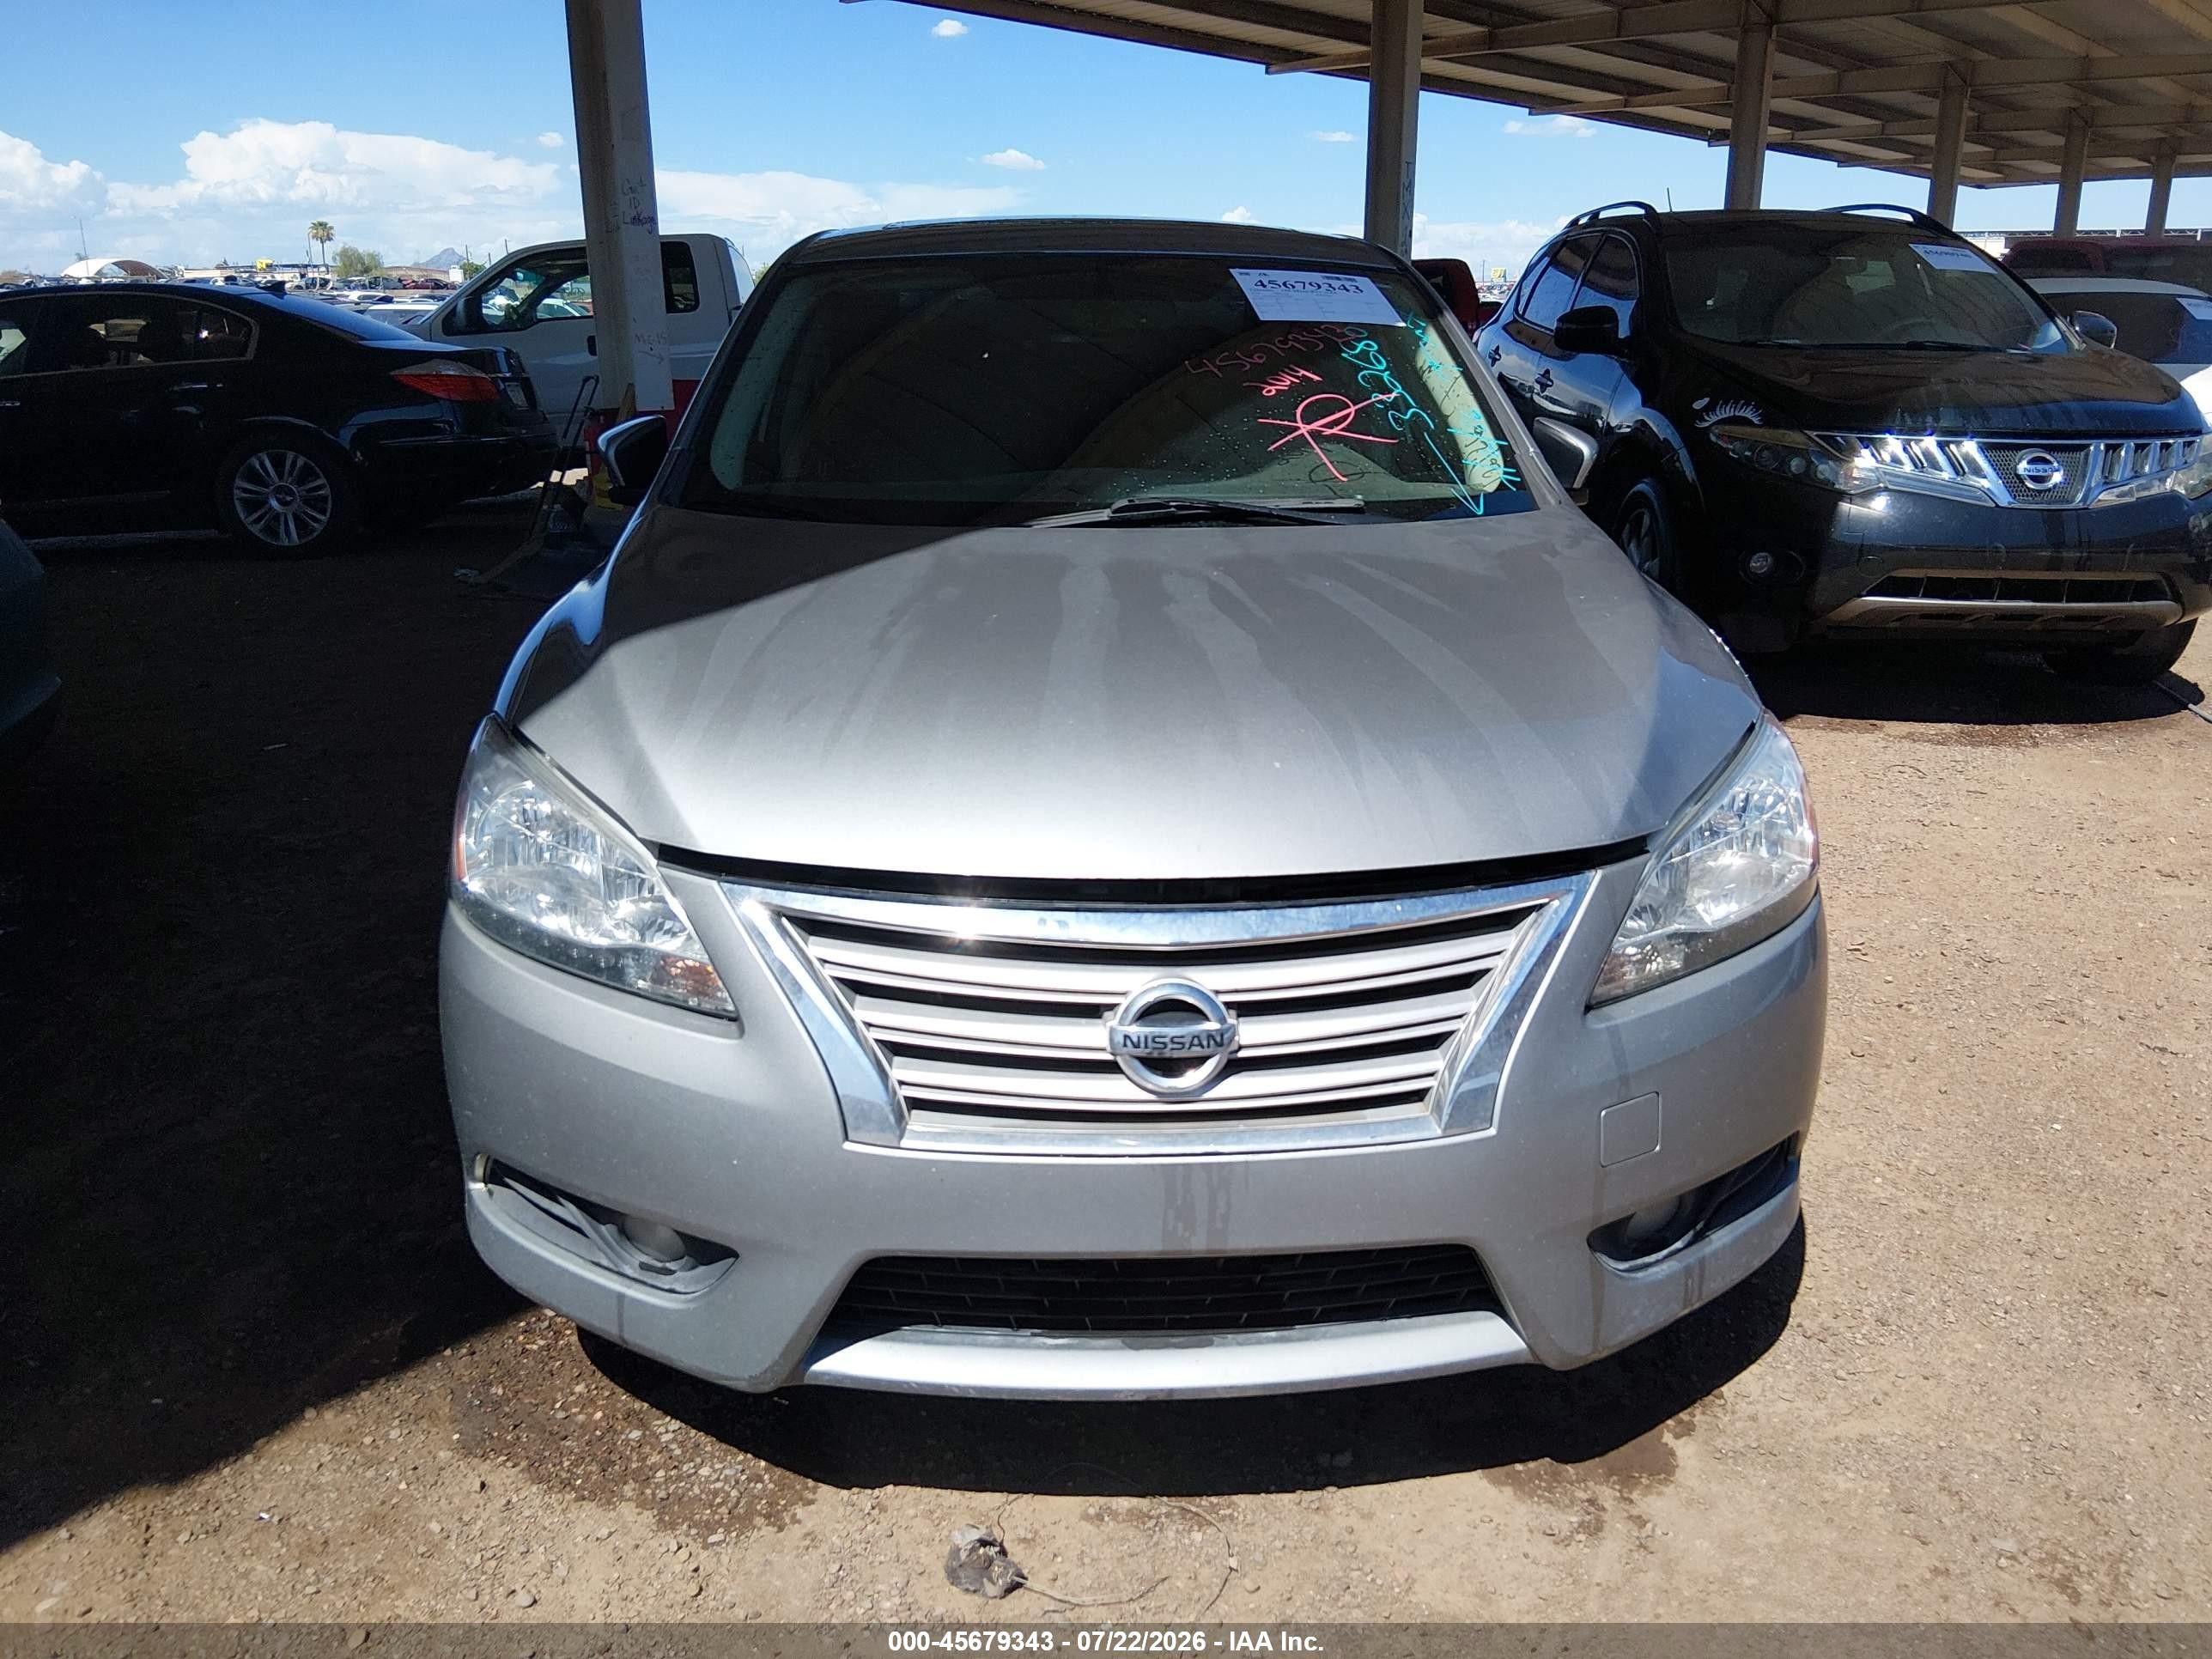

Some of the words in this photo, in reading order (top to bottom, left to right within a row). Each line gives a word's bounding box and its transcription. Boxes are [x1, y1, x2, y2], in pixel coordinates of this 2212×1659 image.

[1254, 279, 1364, 294] 45679343
[1243, 364, 1323, 397] 2014
[1122, 1033, 1224, 1051] NISSAN
